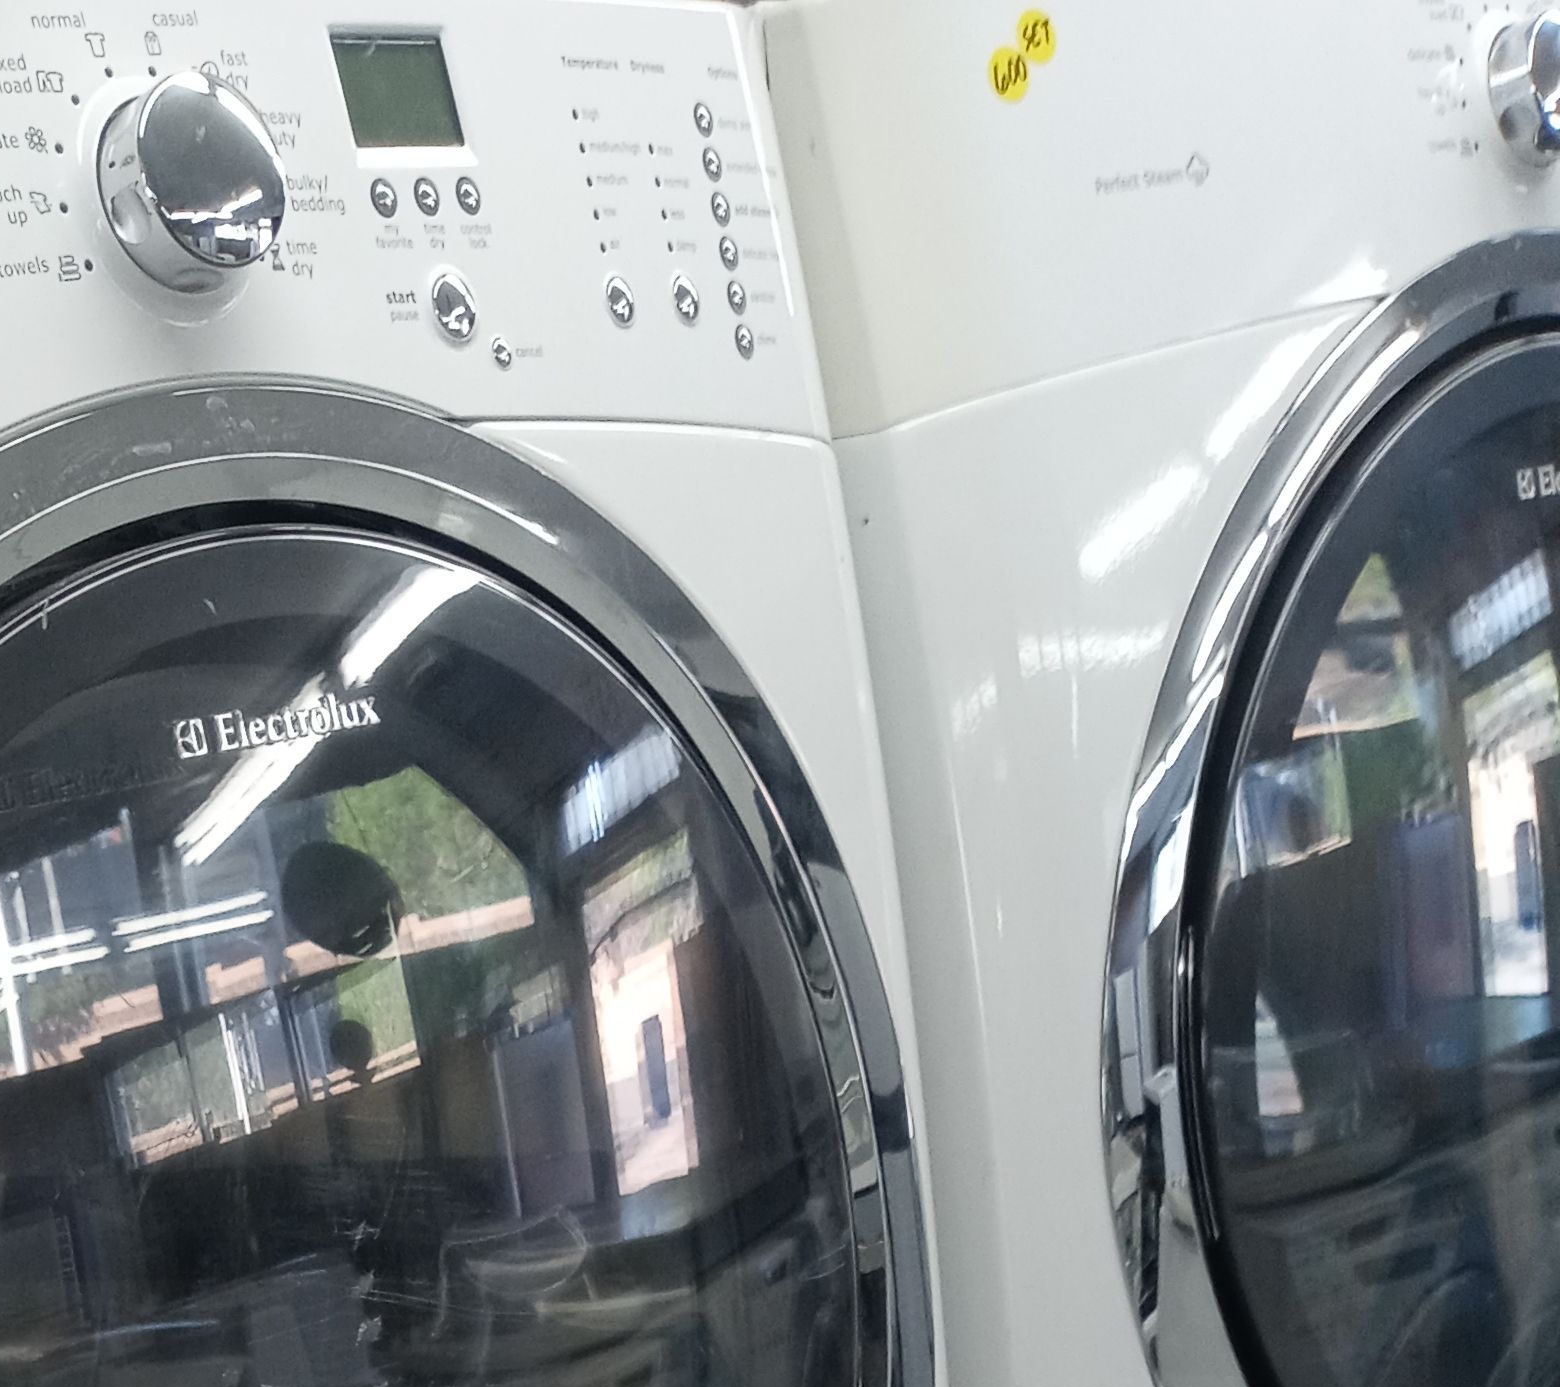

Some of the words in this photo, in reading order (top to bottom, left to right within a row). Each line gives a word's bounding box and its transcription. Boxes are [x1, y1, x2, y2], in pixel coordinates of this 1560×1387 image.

[31, 10, 87, 29] normal
[151, 9, 199, 28] casual
[1022, 18, 1049, 52] SET
[219, 49, 249, 67] fast
[275, 131, 297, 150] uty
[291, 195, 347, 216] bedding
[7, 210, 29, 227] up
[286, 240, 319, 257] time
[292, 259, 315, 280] dry
[385, 290, 418, 305] start
[214, 692, 382, 752] Electrolux
